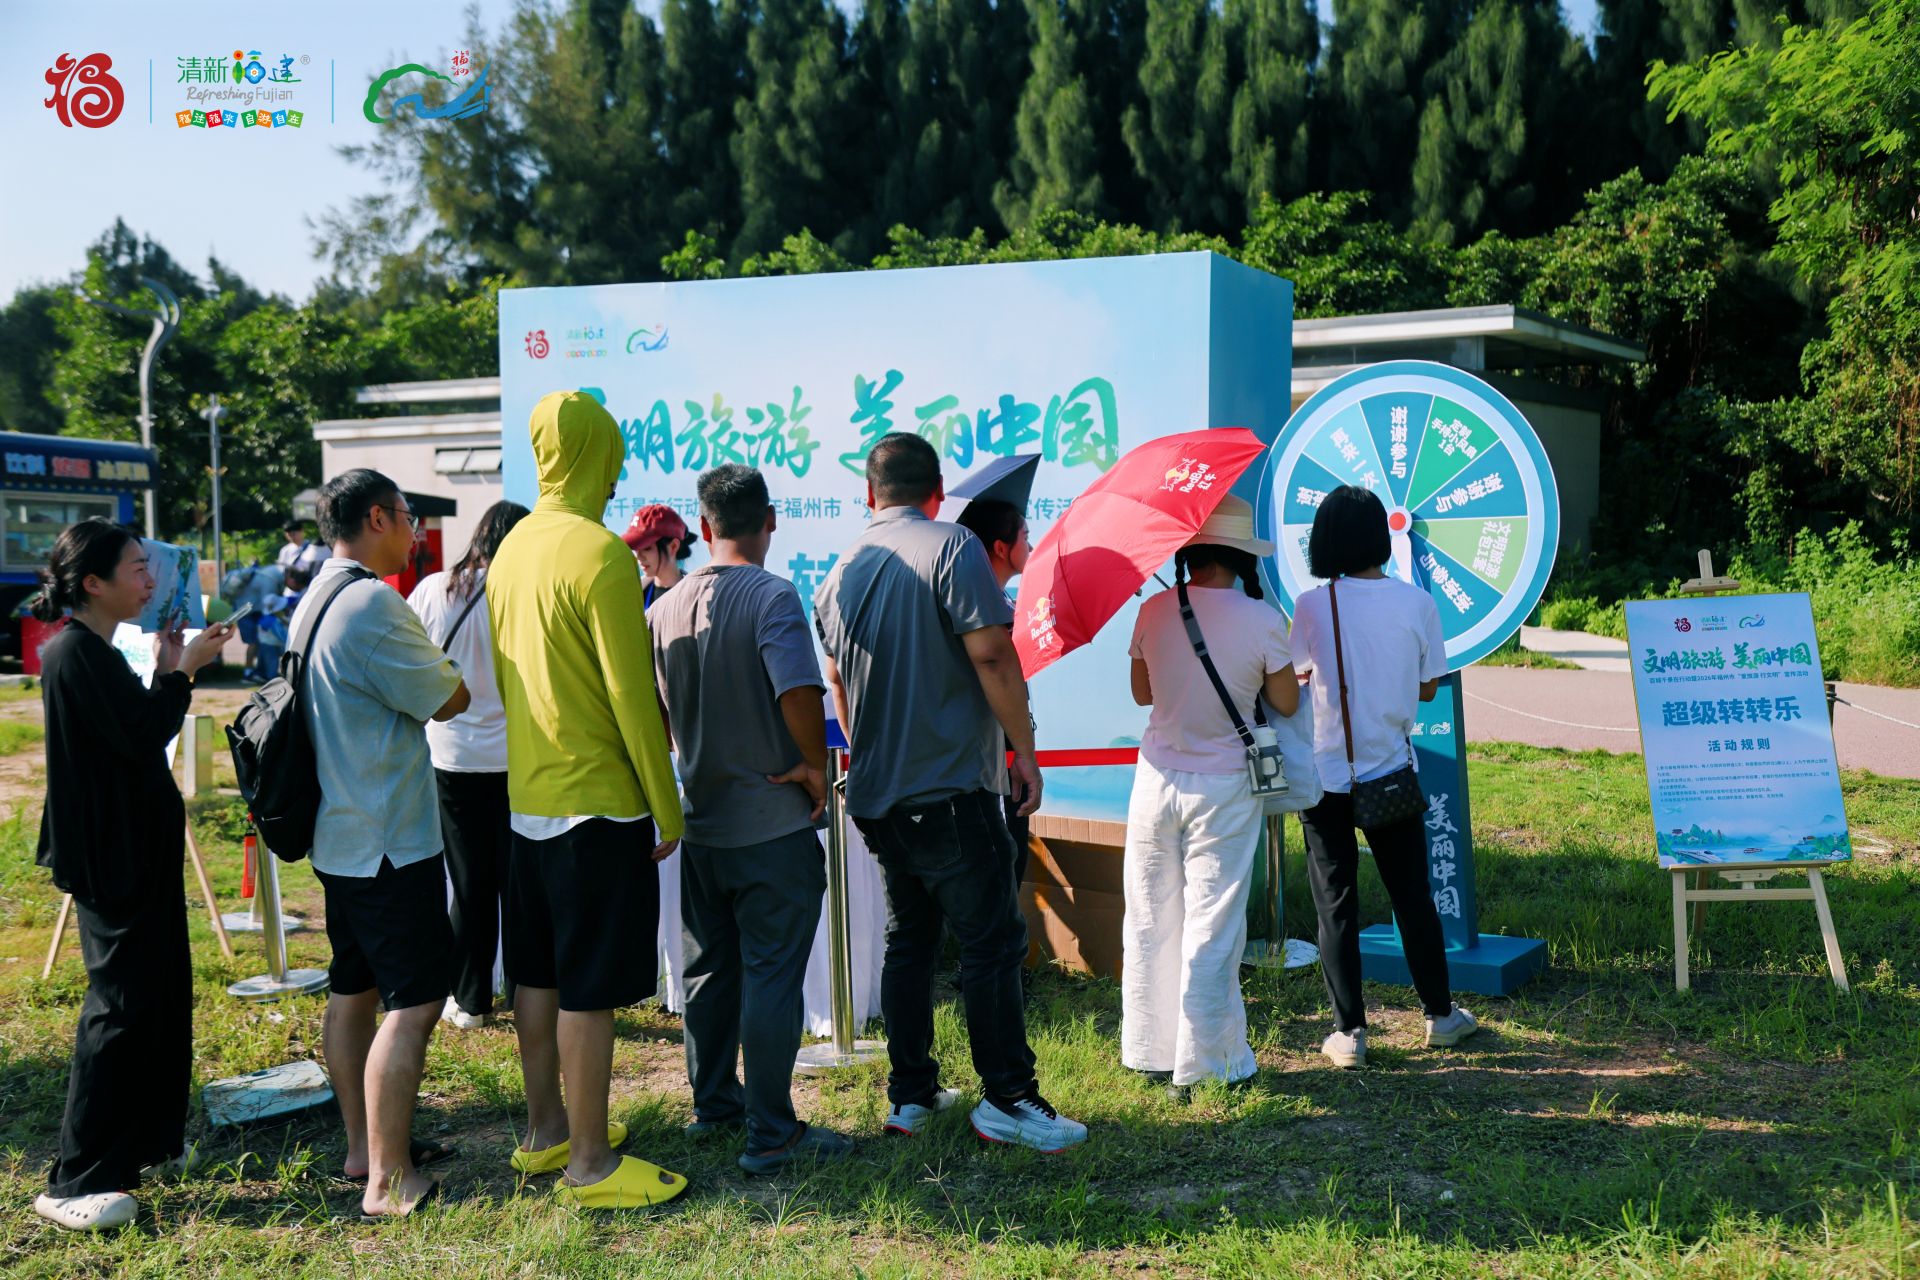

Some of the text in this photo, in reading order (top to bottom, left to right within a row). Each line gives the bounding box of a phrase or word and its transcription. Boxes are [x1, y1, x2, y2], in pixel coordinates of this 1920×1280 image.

[580, 386, 820, 481] 明旅游
[1390, 406, 1408, 478] 谢谢参与
[1435, 472, 1504, 513] 谢谢参与
[1486, 521, 1512, 579] 文明旅游
[1420, 551, 1475, 615] 谢谢参与
[1642, 642, 1812, 673] 文明旅游 美丽中国
[1662, 695, 1802, 727] 超级转转乐
[1708, 737, 1770, 752] 活动规则
[1425, 793, 1460, 918] 美丽中国
